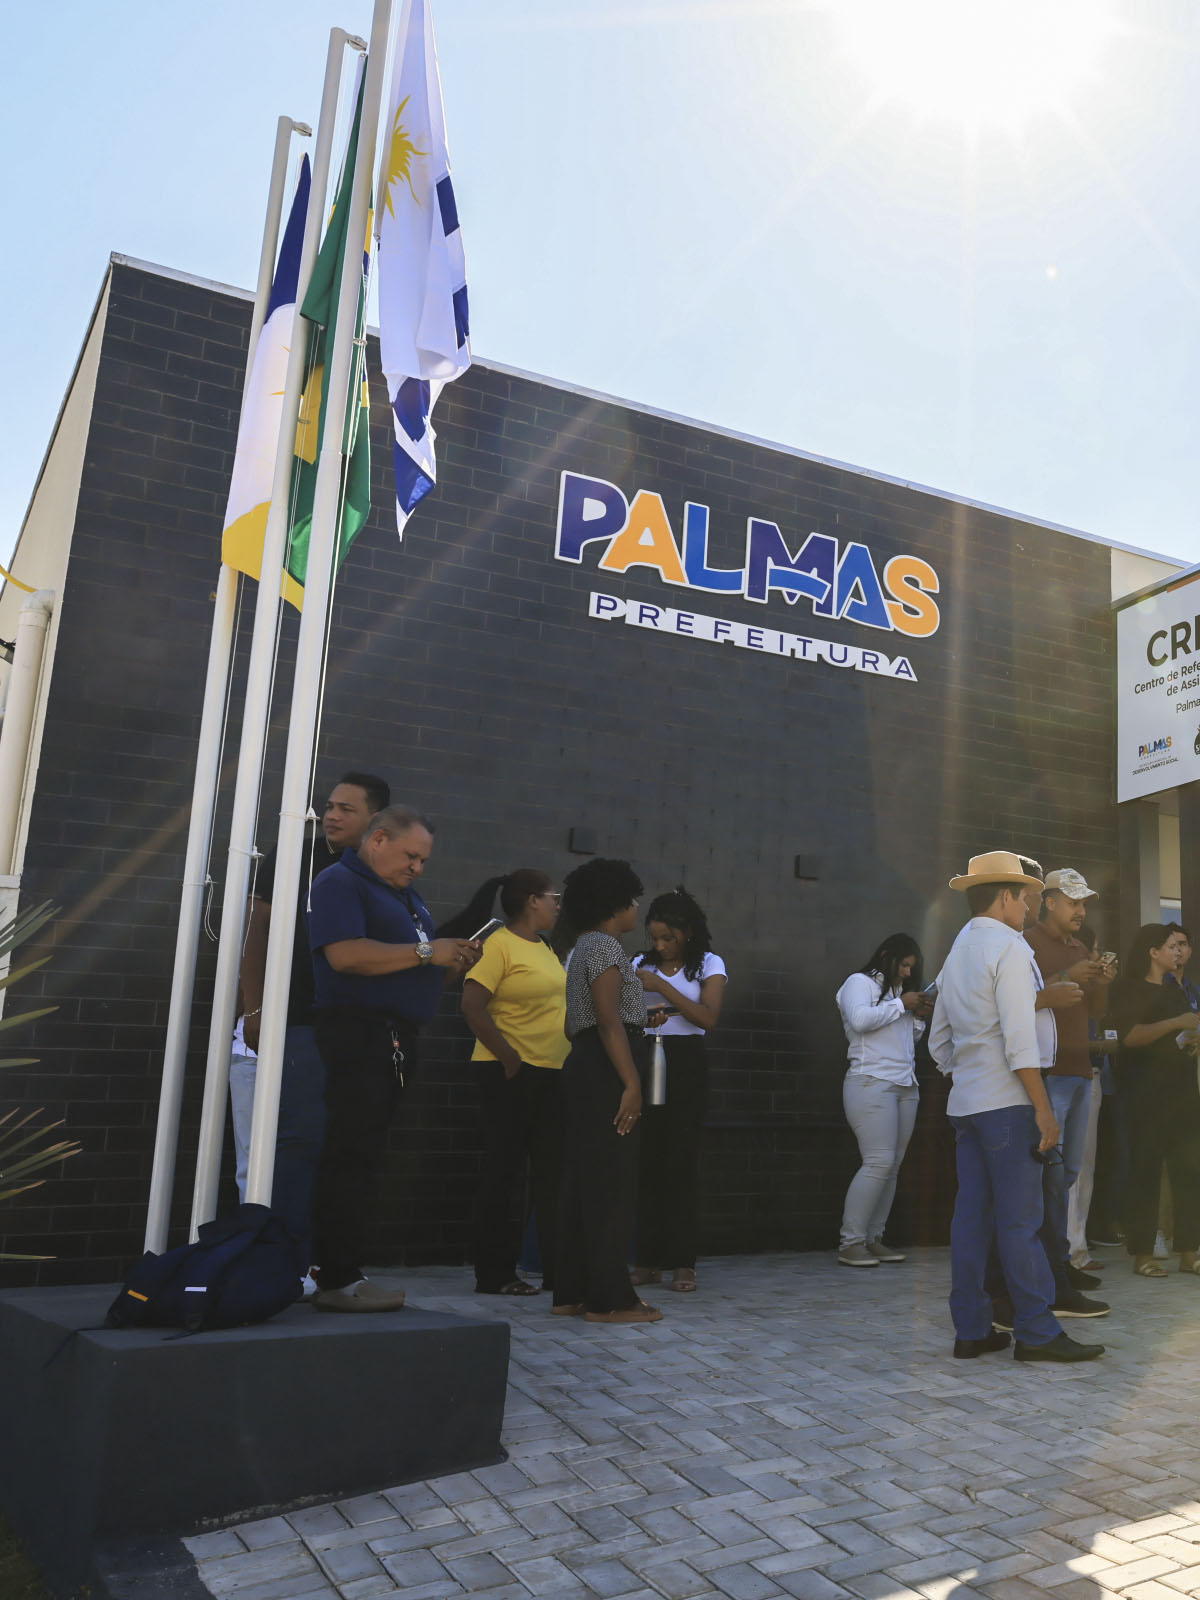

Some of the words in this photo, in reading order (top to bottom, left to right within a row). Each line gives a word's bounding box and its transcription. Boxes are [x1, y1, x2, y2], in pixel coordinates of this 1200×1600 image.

[554, 470, 940, 638] PALMAS
[590, 592, 916, 681] PREFEITURA
[1134, 676, 1165, 694] Centro
[1167, 670, 1179, 682] de
[1166, 684, 1179, 696] de
[1138, 735, 1173, 757] PALMAS
